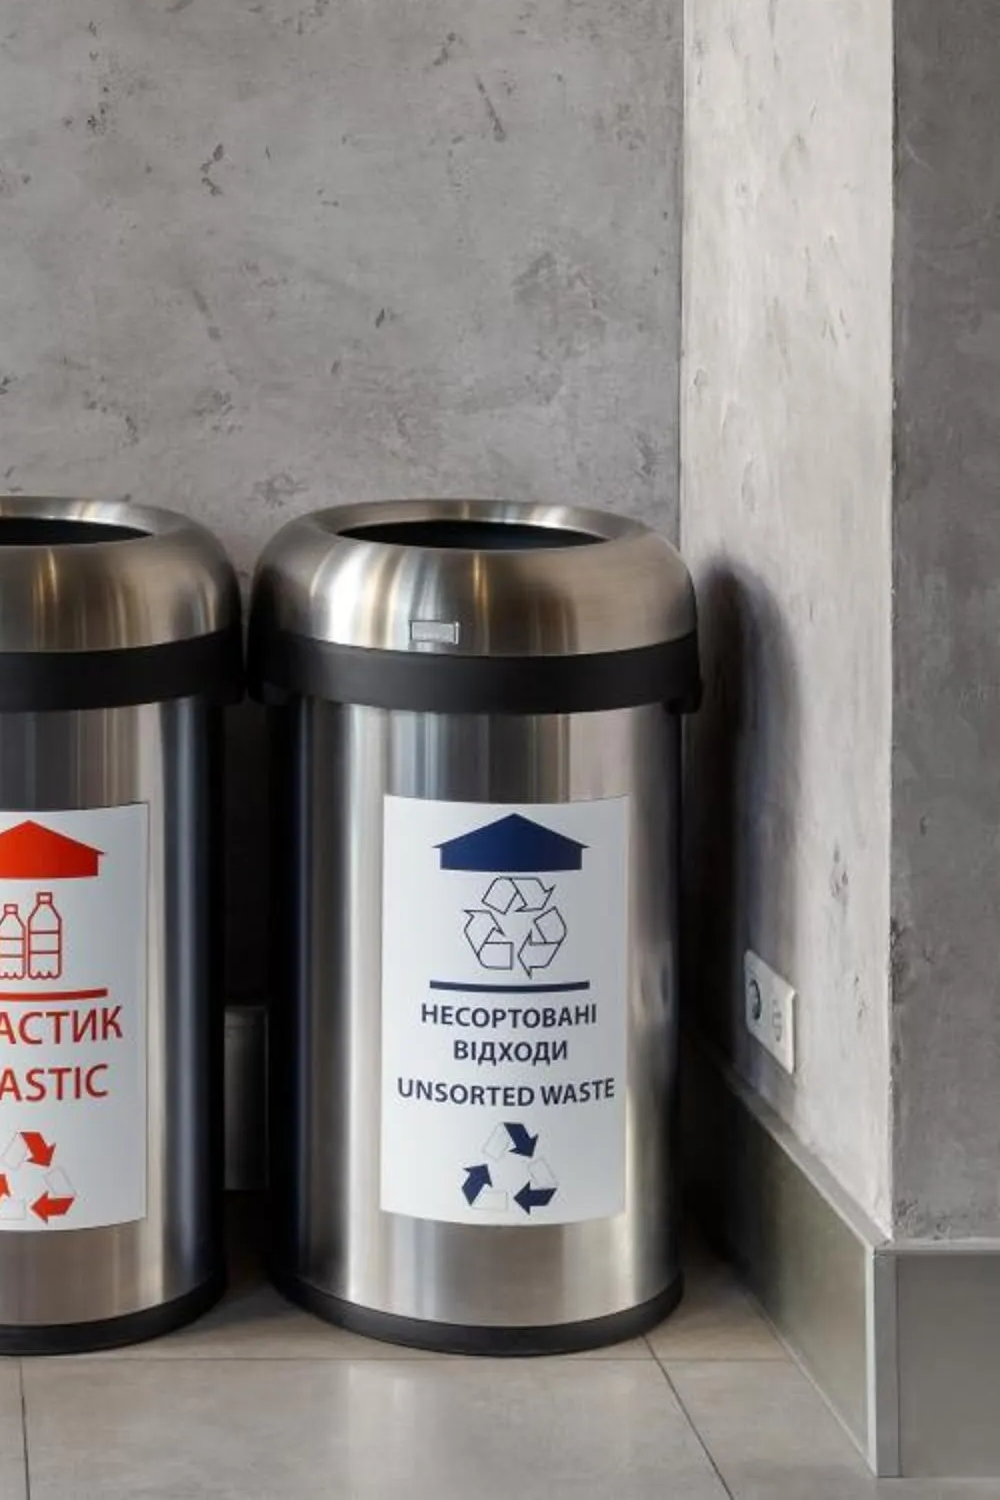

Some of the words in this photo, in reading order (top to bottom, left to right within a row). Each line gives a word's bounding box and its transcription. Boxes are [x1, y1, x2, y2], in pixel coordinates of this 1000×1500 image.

[422, 1004, 596, 1028] НЕСОРТОВАНІ
[455, 1040, 567, 1066] ВІДХОДИ
[398, 1078, 535, 1107] UNSORTED
[540, 1078, 614, 1105] WASTE
